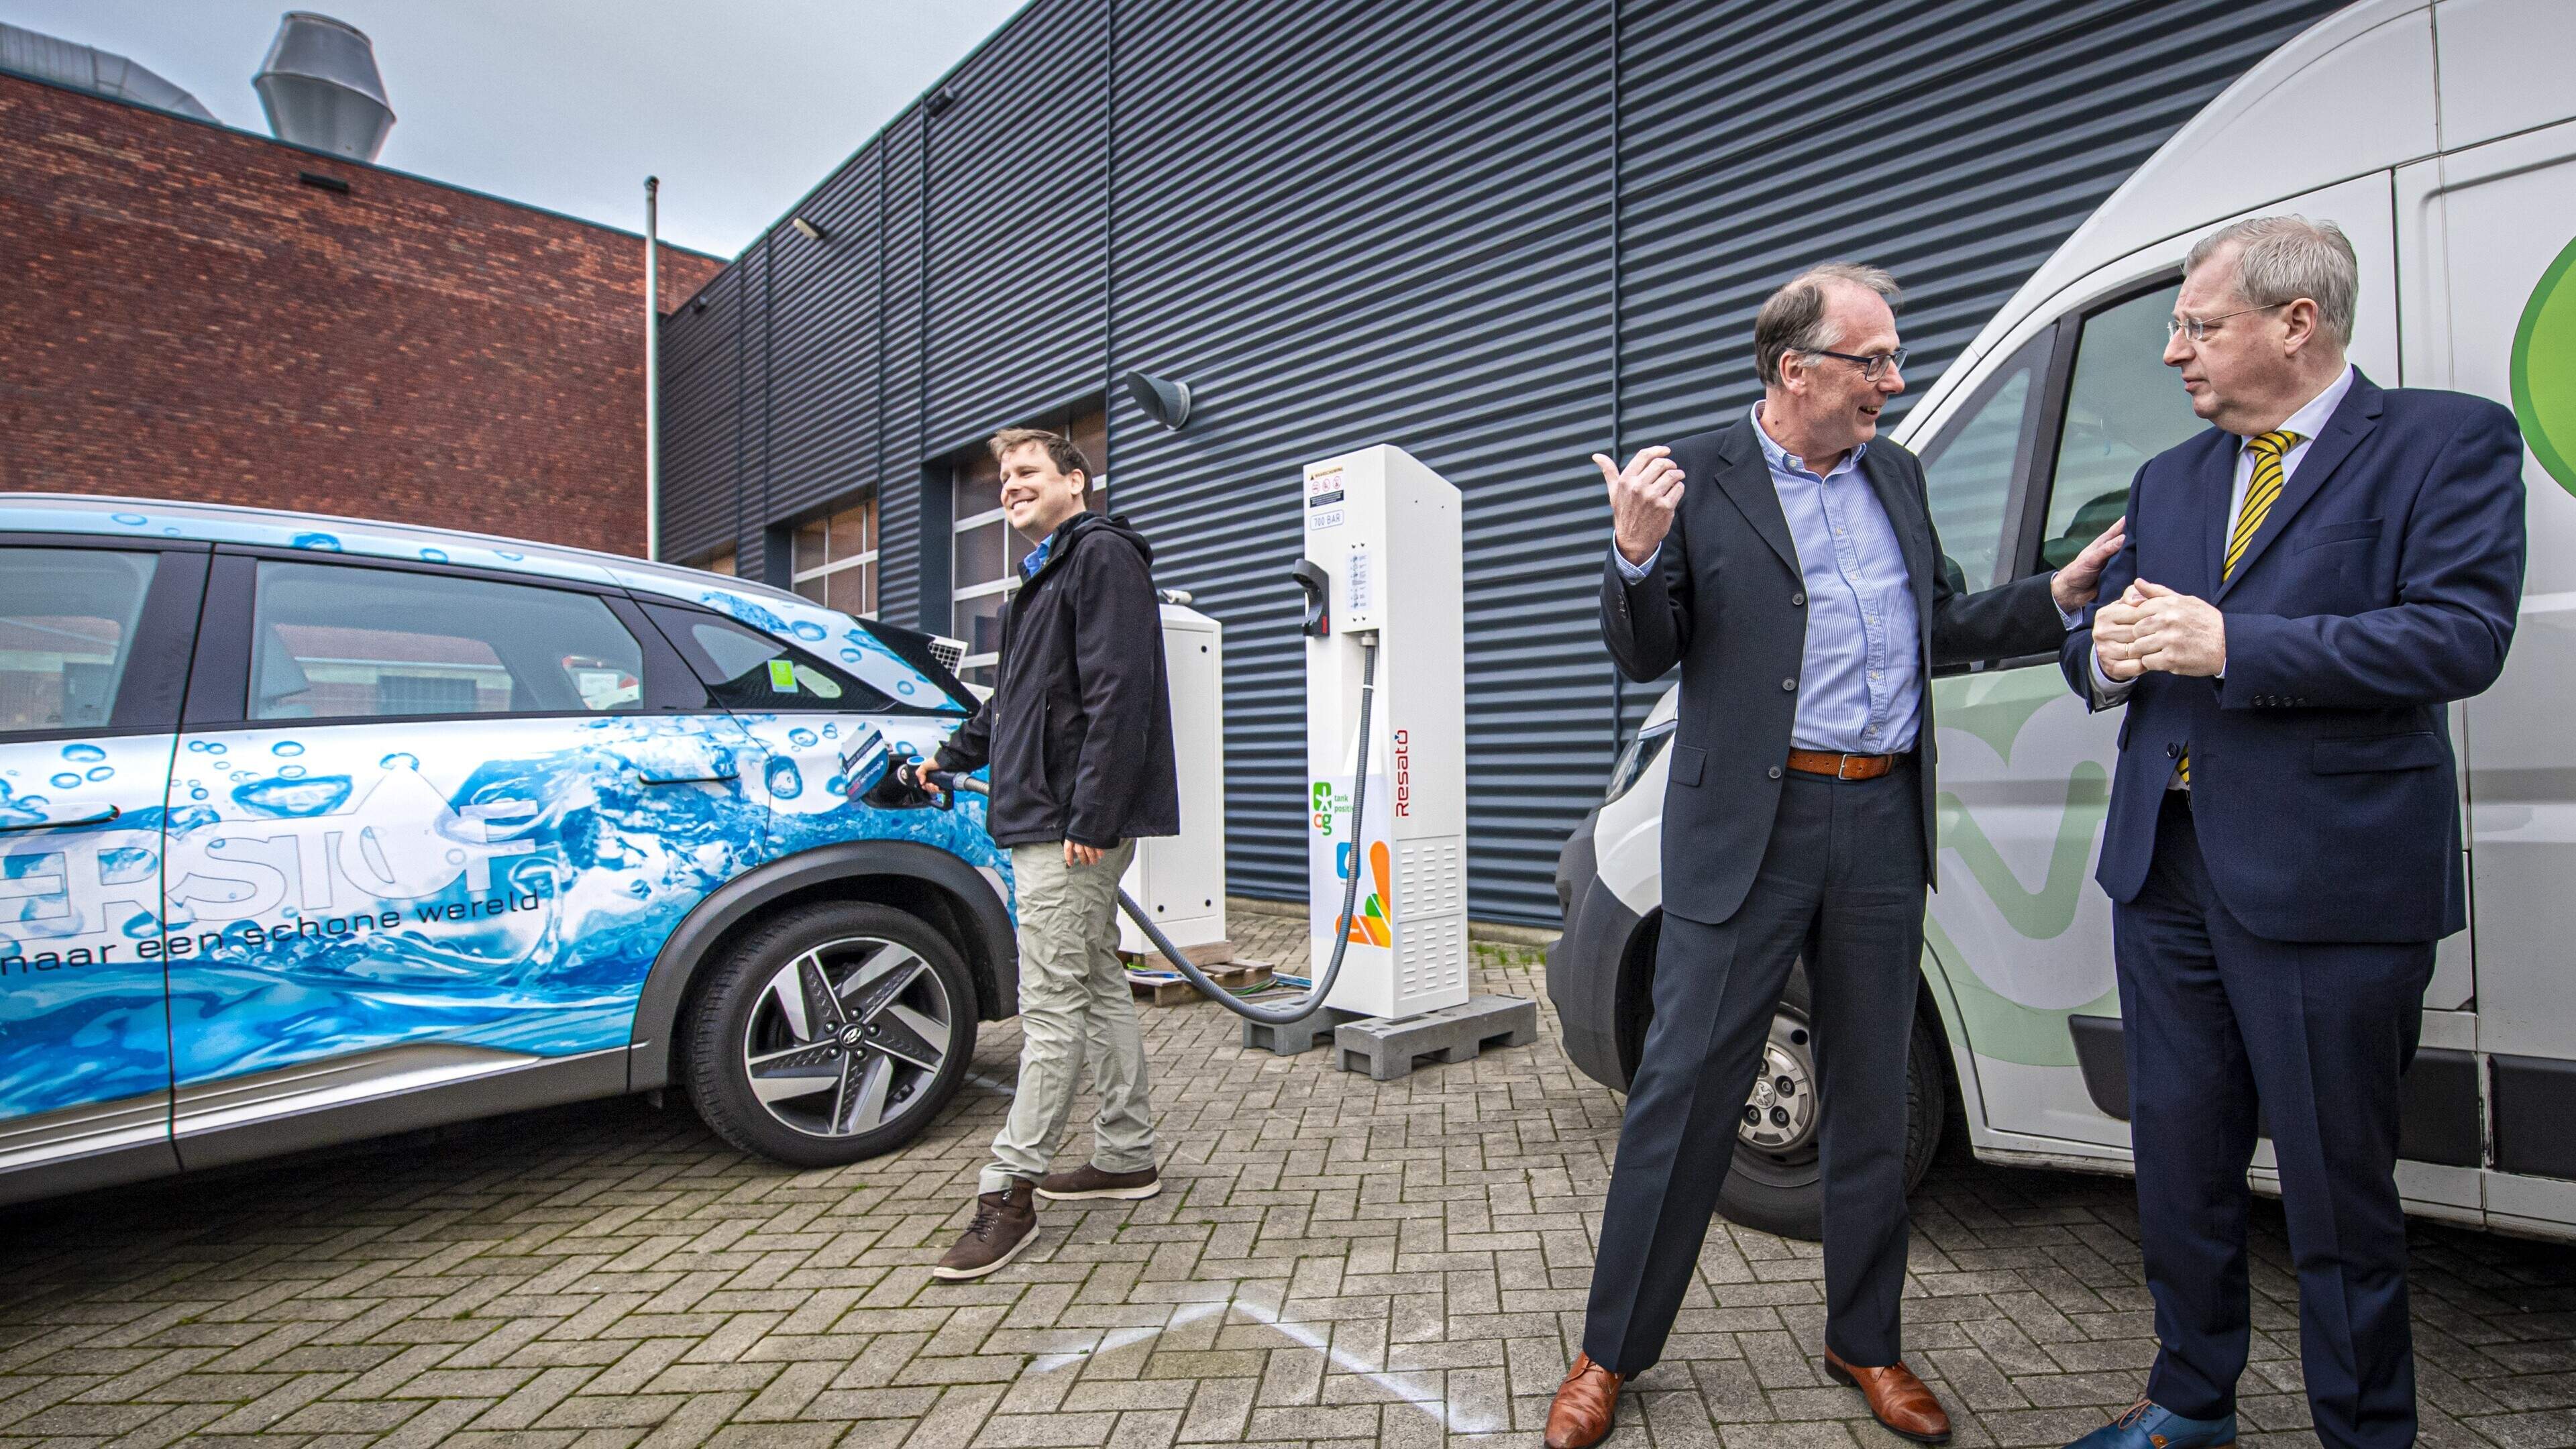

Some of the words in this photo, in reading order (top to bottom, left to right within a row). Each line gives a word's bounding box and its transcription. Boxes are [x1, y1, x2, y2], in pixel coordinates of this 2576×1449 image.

[1313, 517, 1325, 527] 700
[1327, 513, 1340, 525] BAR
[1334, 794, 1348, 802] tank
[0, 944, 117, 976] naar
[136, 932, 223, 959] een
[244, 911, 400, 945] schone
[417, 890, 539, 923] wereld
